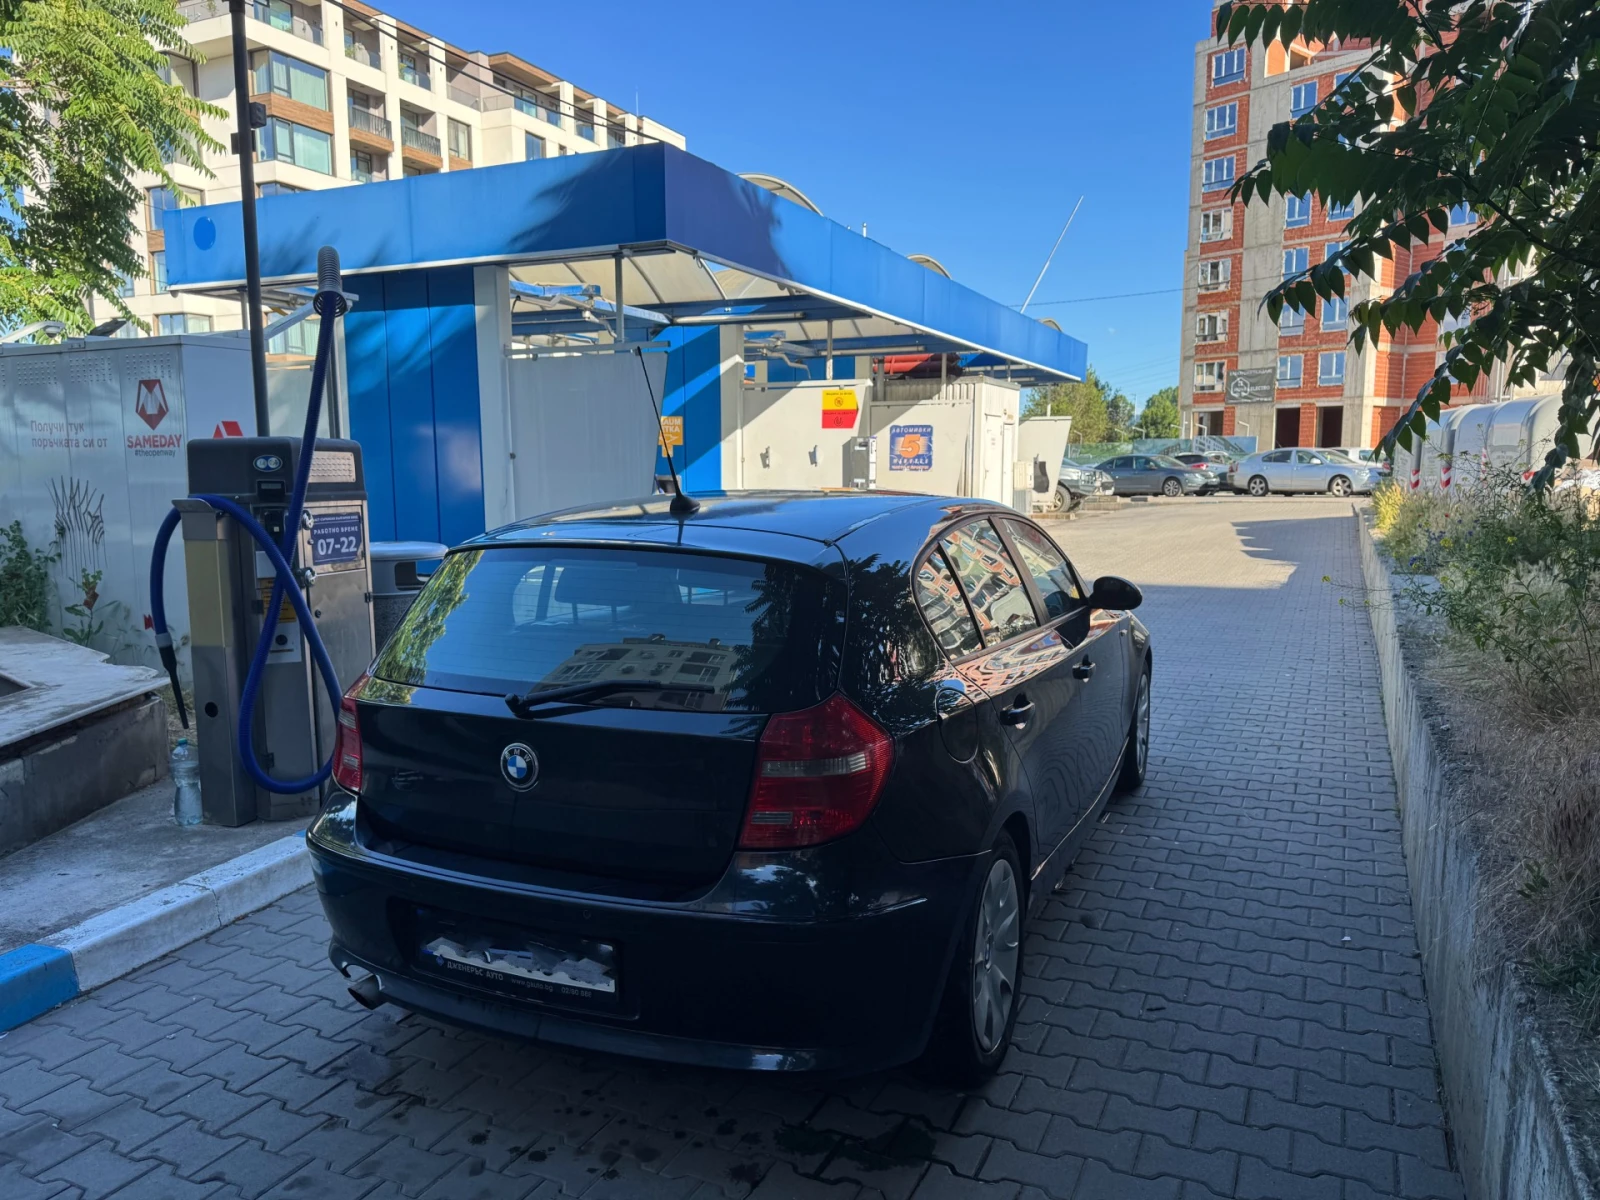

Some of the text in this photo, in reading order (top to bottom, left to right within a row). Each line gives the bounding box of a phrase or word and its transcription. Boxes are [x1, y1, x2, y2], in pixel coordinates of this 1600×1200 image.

[30, 420, 85, 435] Получи тук
[32, 437, 108, 449] поръчката си от
[127, 434, 182, 449] SAMEDAY
[899, 433, 921, 458] 5
[134, 449, 176, 458] #theopenway
[313, 525, 358, 535] РАБОТНО ВРЕМЕ
[317, 536, 357, 556] 07-22
[504, 748, 531, 762] BMW
